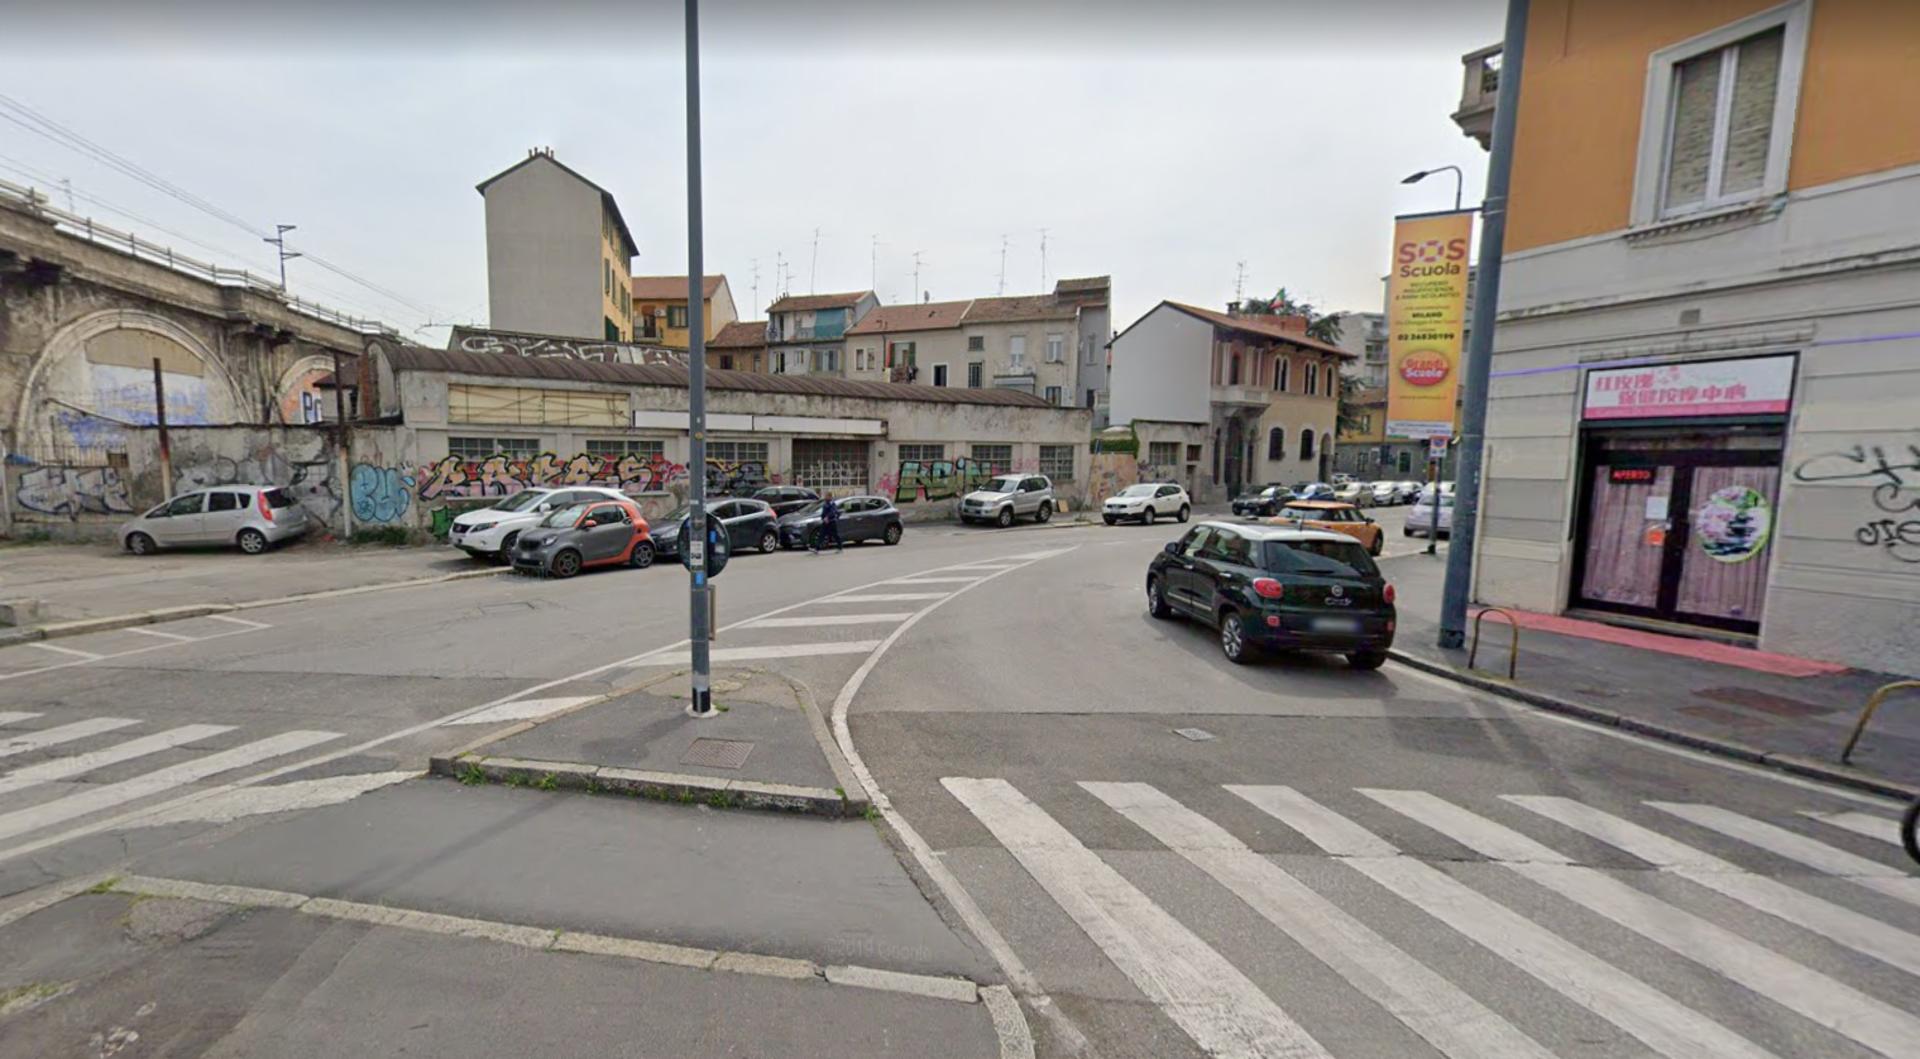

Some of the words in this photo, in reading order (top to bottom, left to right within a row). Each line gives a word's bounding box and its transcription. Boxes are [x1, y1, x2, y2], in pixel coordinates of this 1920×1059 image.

[1397, 238, 1466, 264] SOS
[1400, 262, 1460, 278] Scuola
[1412, 311, 1443, 319] MILANO
[1406, 358, 1443, 369] Grandi
[1405, 367, 1444, 378] Scuole
